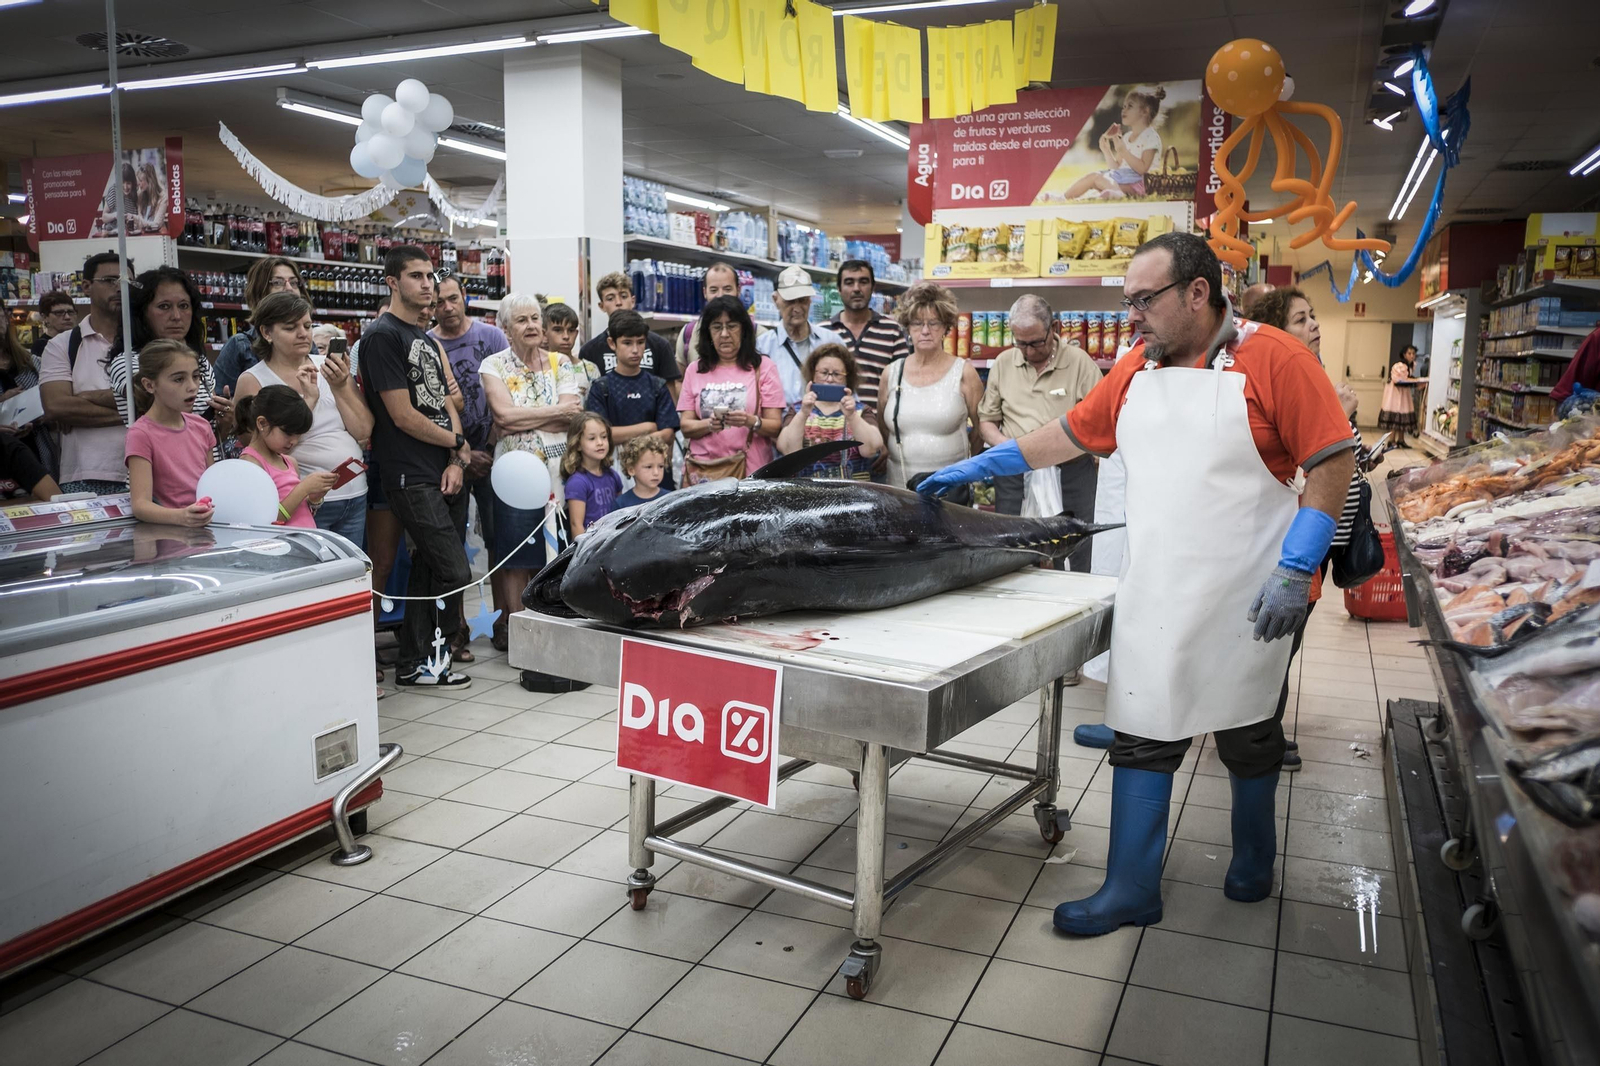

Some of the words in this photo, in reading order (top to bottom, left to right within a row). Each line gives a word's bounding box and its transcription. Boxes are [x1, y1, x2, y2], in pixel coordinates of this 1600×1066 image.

[953, 115, 973, 124] Con
[976, 114, 996, 123] una
[997, 112, 1021, 124] gran
[1023, 107, 1071, 120] selección
[953, 127, 967, 138] de
[969, 126, 997, 137] frutas
[998, 127, 1006, 138] y
[1006, 123, 1052, 135] verduras
[953, 141, 987, 153] traídas
[989, 139, 1020, 151] desde
[1022, 138, 1032, 149] el
[1033, 138, 1070, 150] campo
[914, 144, 933, 187] Agua
[952, 157, 976, 169] para
[978, 155, 985, 165] ti
[42, 170, 52, 179] Con
[52, 169, 61, 178] las
[61, 168, 82, 180] mejores
[43, 180, 76, 189] promociones
[171, 164, 181, 214] Bebidas
[44, 190, 69, 200] pensadas
[69, 190, 82, 200] para
[26, 178, 37, 234] Mascotas
[622, 681, 705, 744] Dia
